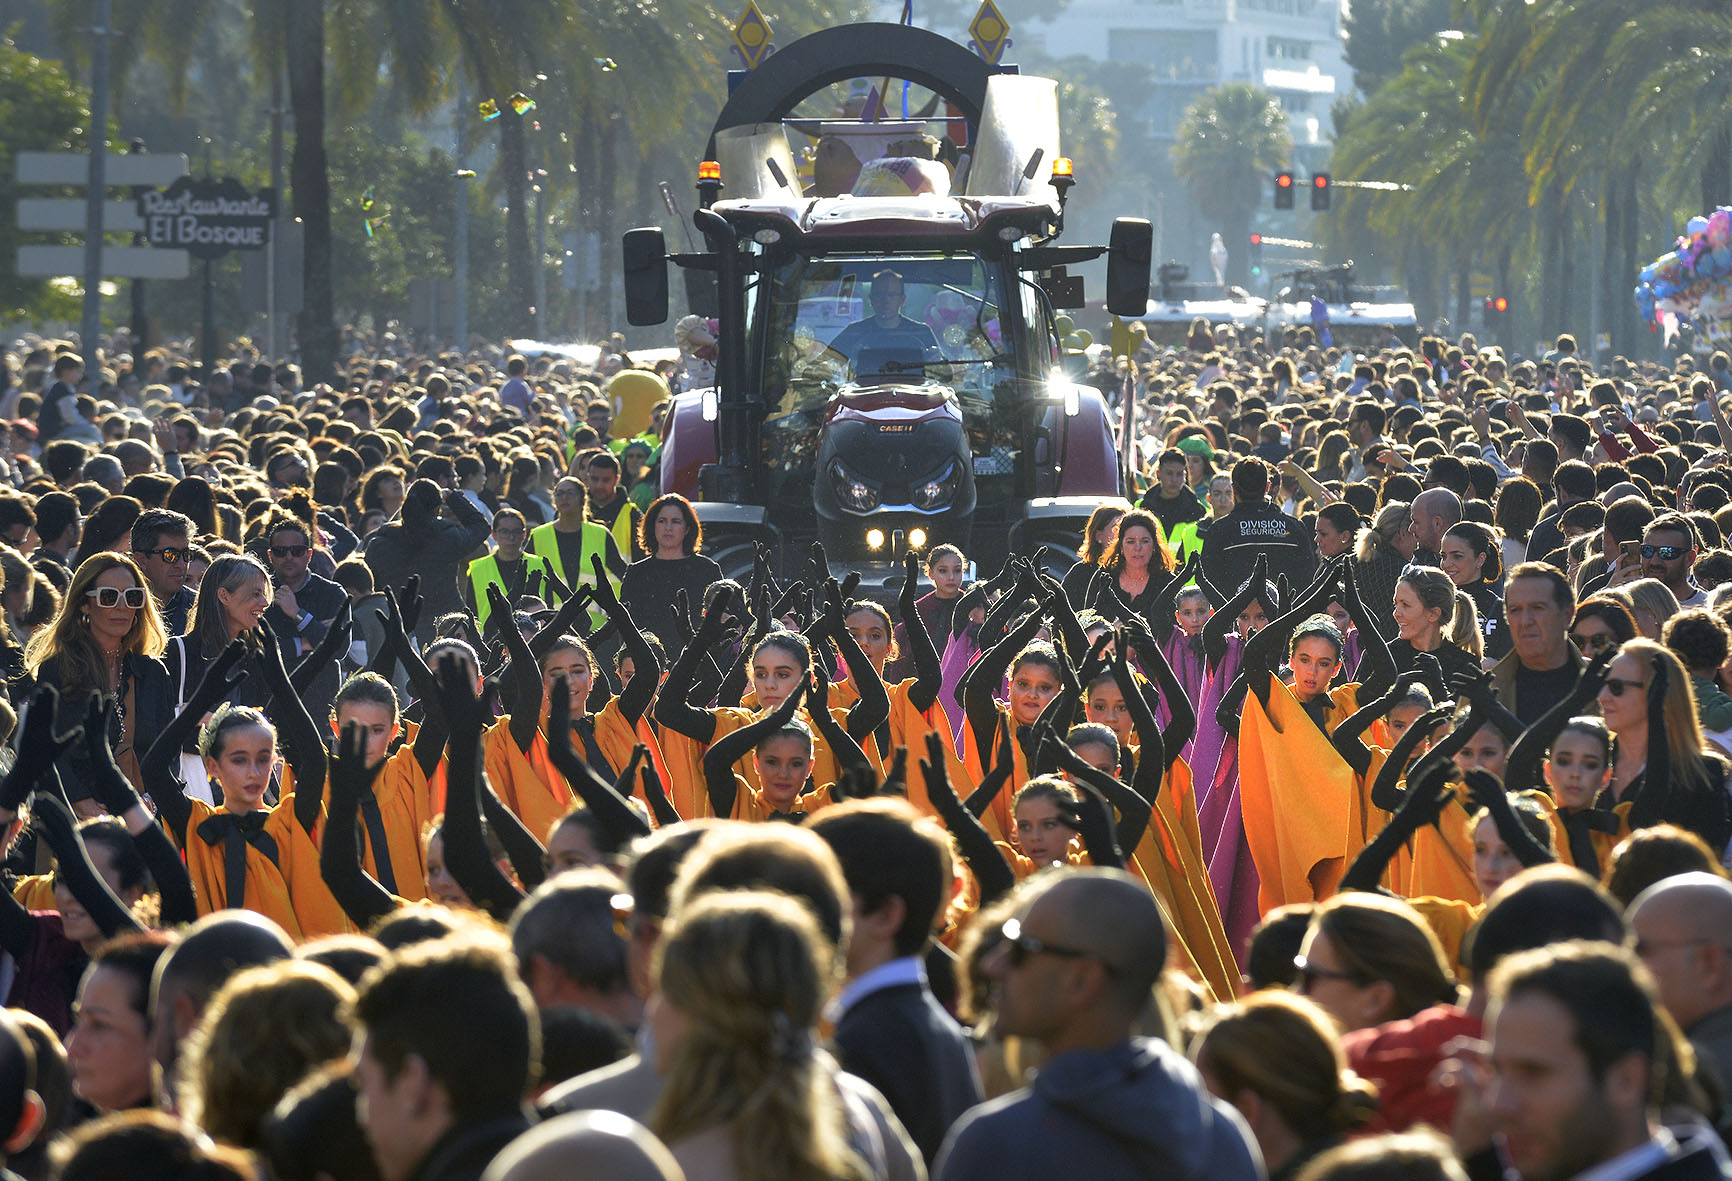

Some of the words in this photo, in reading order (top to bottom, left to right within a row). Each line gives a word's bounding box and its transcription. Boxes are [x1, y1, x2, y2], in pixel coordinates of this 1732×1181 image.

[150, 215, 173, 243] El
[1239, 519, 1286, 529] DIVISIÓN
[1240, 528, 1287, 536] SEGURIDAD
